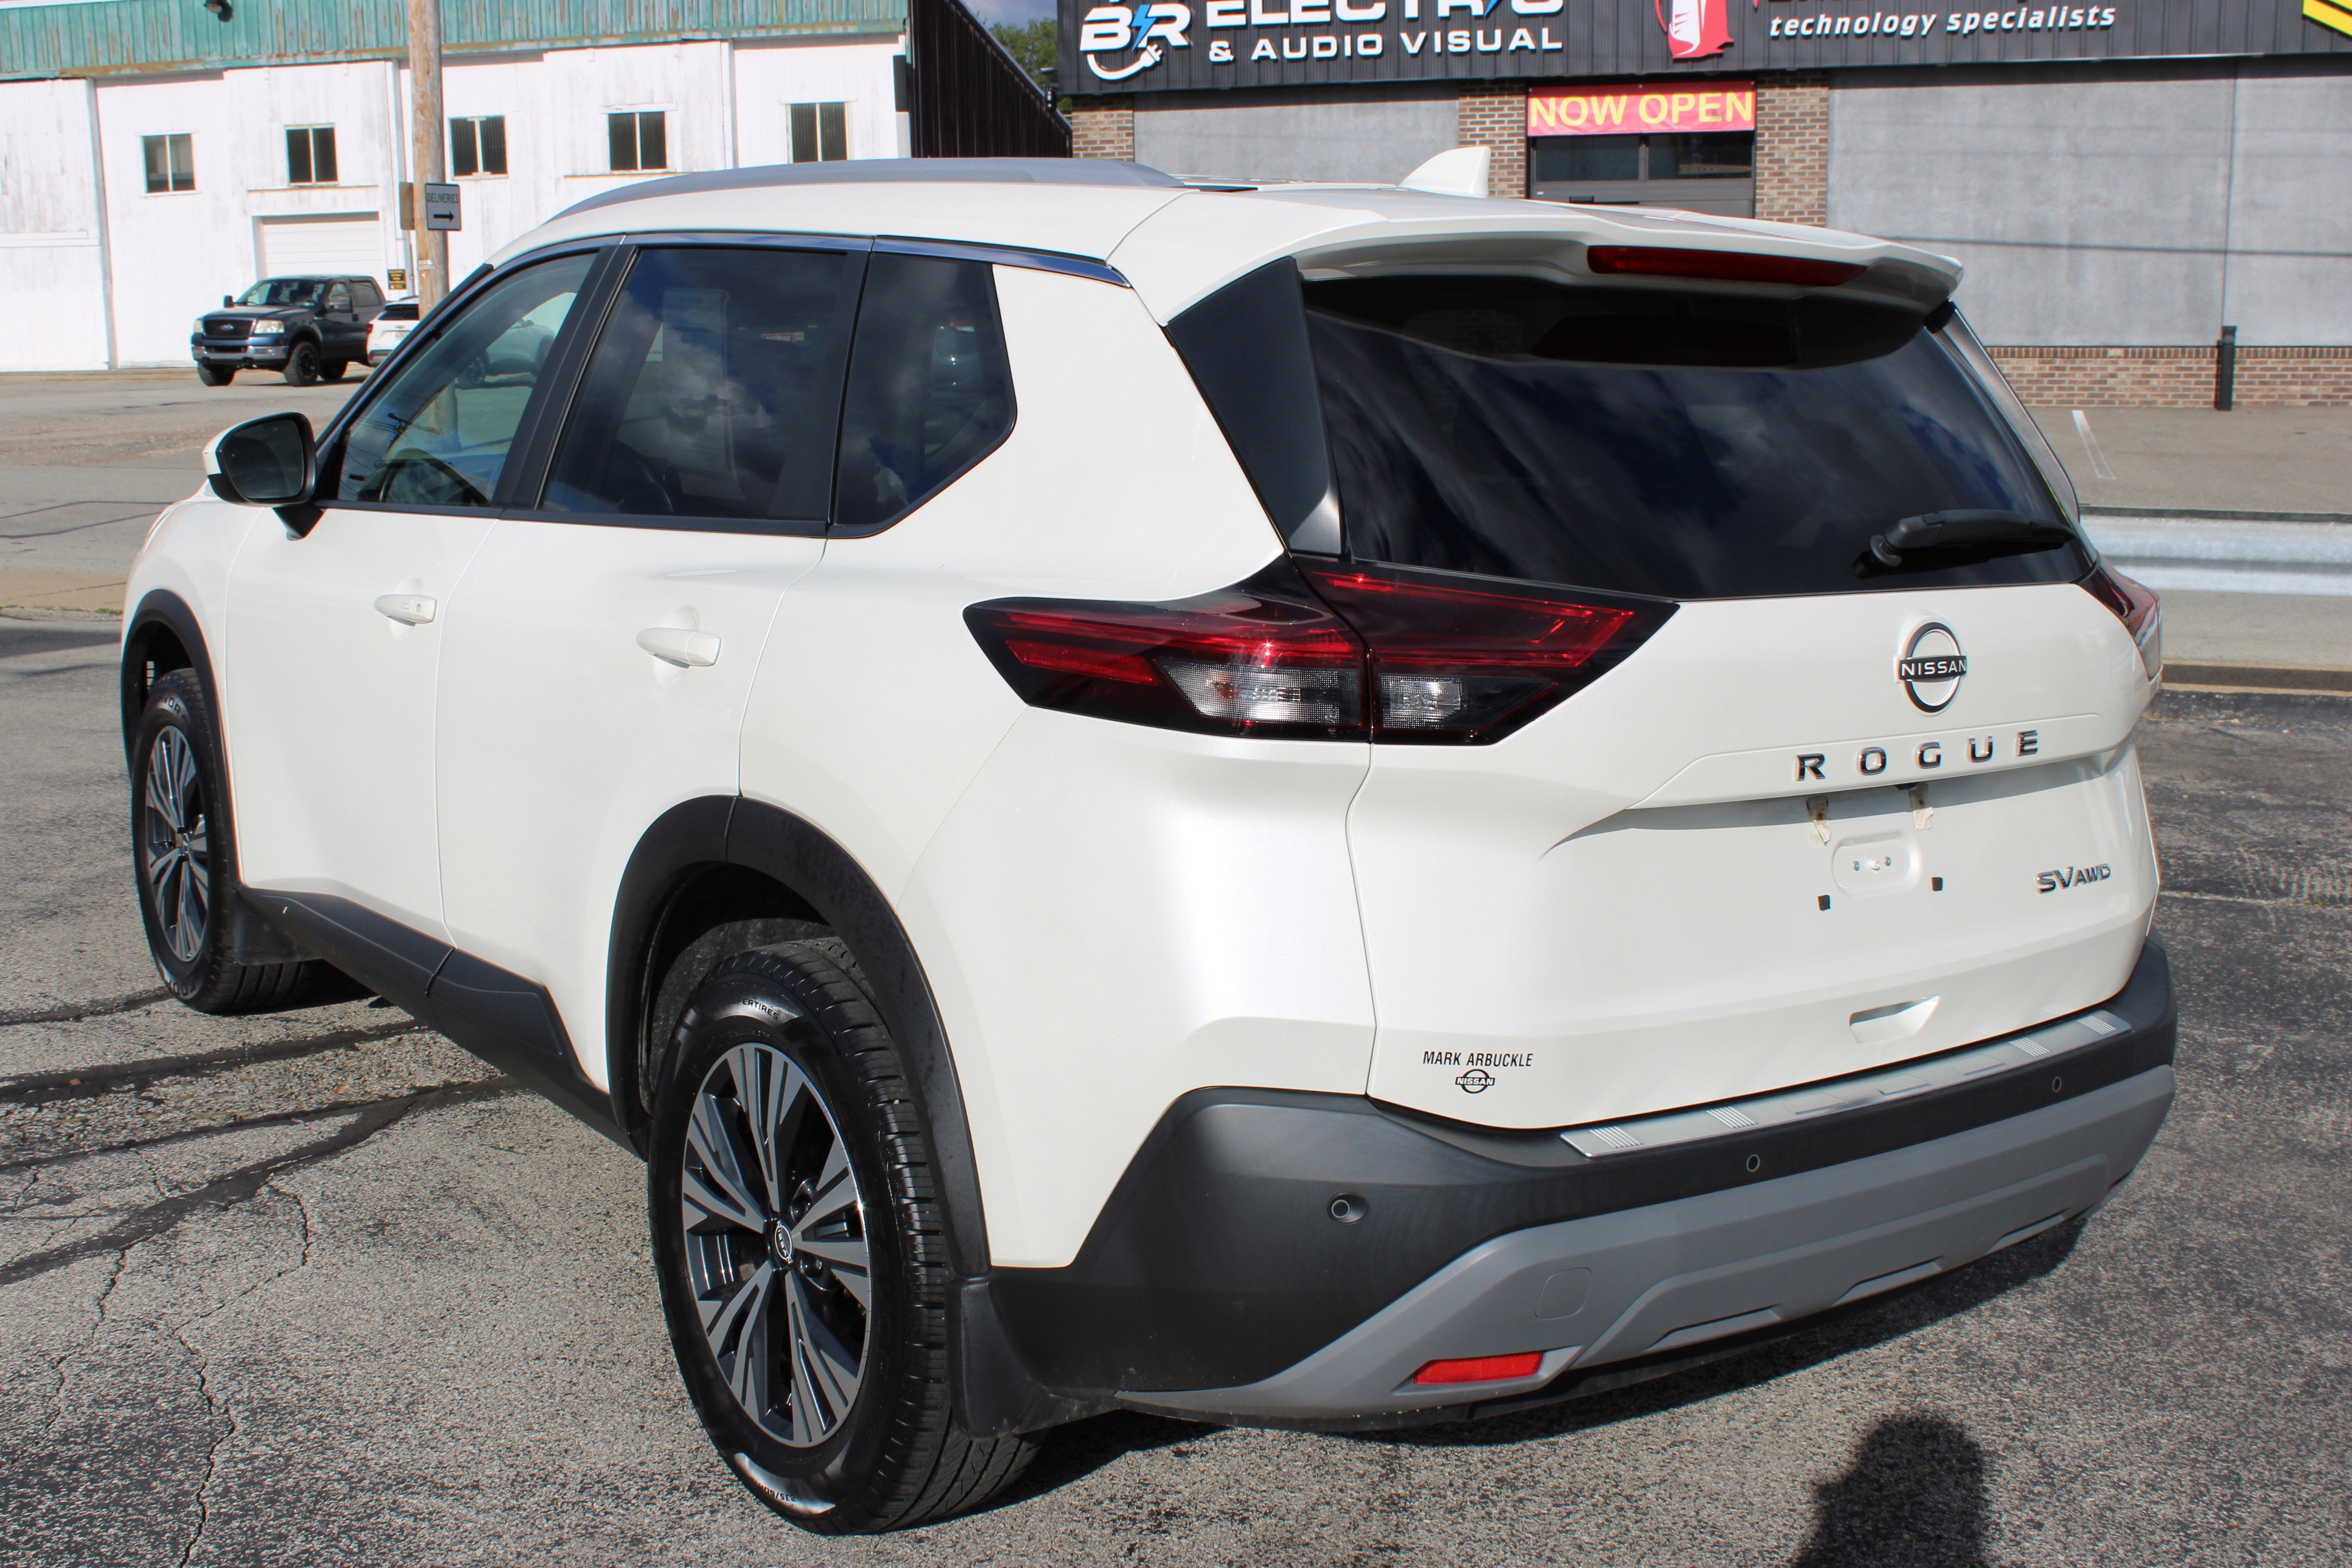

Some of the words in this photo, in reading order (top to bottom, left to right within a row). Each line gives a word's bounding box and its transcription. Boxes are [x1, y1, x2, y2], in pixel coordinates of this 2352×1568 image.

[1770, 12, 1937, 36] technology
[1946, 6, 2116, 34] specialists
[1209, 40, 1234, 62] &
[1251, 33, 1383, 60] AUDIO
[1399, 28, 1563, 54] VISUAL
[1530, 94, 1628, 127] NOW
[1638, 90, 1753, 124] OPEN
[427, 192, 459, 203] DELIVERIES
[1901, 659, 1967, 676] NISSAN
[1795, 730, 2039, 781] ROGUE
[1423, 1051, 1462, 1065] MARK
[1466, 1052, 1533, 1067] ARBUCKLE
[1457, 1077, 1494, 1085] NISSAN
